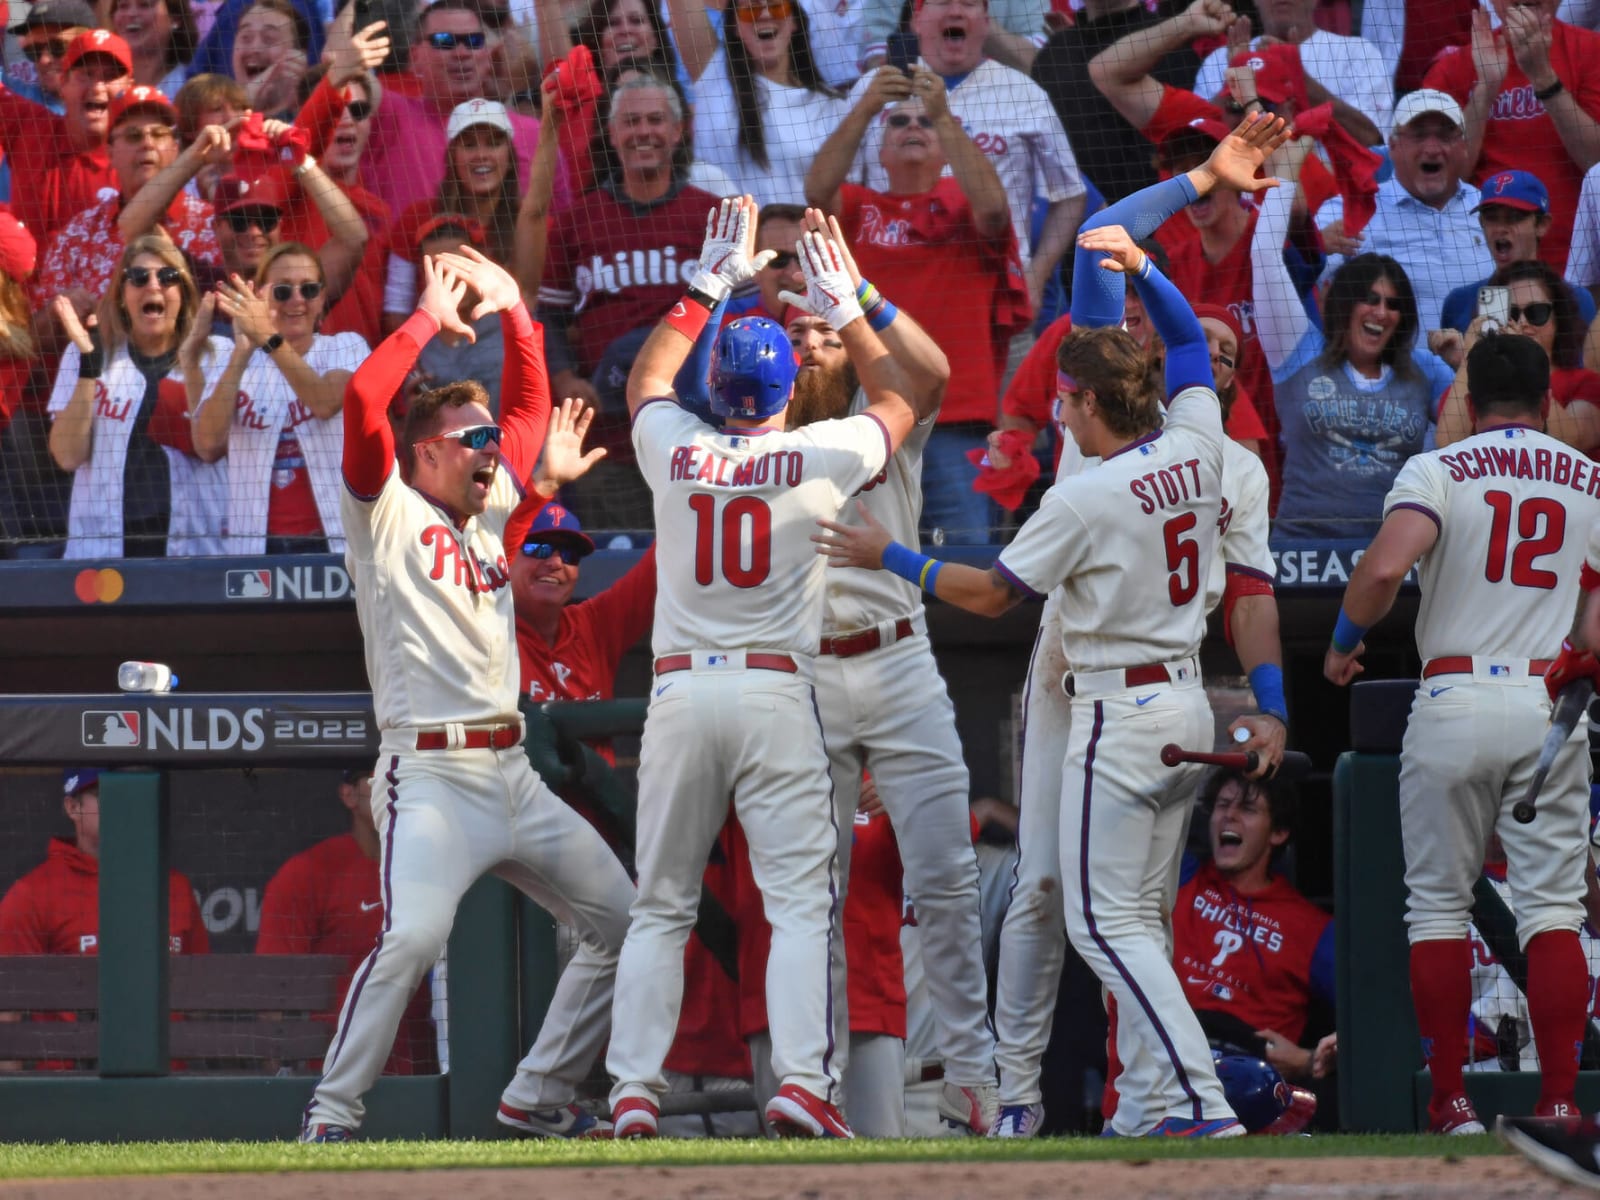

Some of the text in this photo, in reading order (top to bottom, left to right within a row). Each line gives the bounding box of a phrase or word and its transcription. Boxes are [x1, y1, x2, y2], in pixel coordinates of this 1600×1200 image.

[1494, 174, 1514, 194] P
[670, 446, 804, 488] REALMOTO
[1130, 458, 1202, 515] STOTT
[1439, 446, 1600, 500] SCHWARBER
[547, 504, 566, 528] P
[689, 493, 772, 589] 10
[1163, 511, 1200, 607] 5
[1484, 489, 1567, 590] 12
[276, 566, 357, 600] NLD
[147, 707, 367, 751] NLDS 2022
[1213, 929, 1244, 967] P
[1452, 1097, 1471, 1112] 12
[1553, 1103, 1569, 1117] 12
